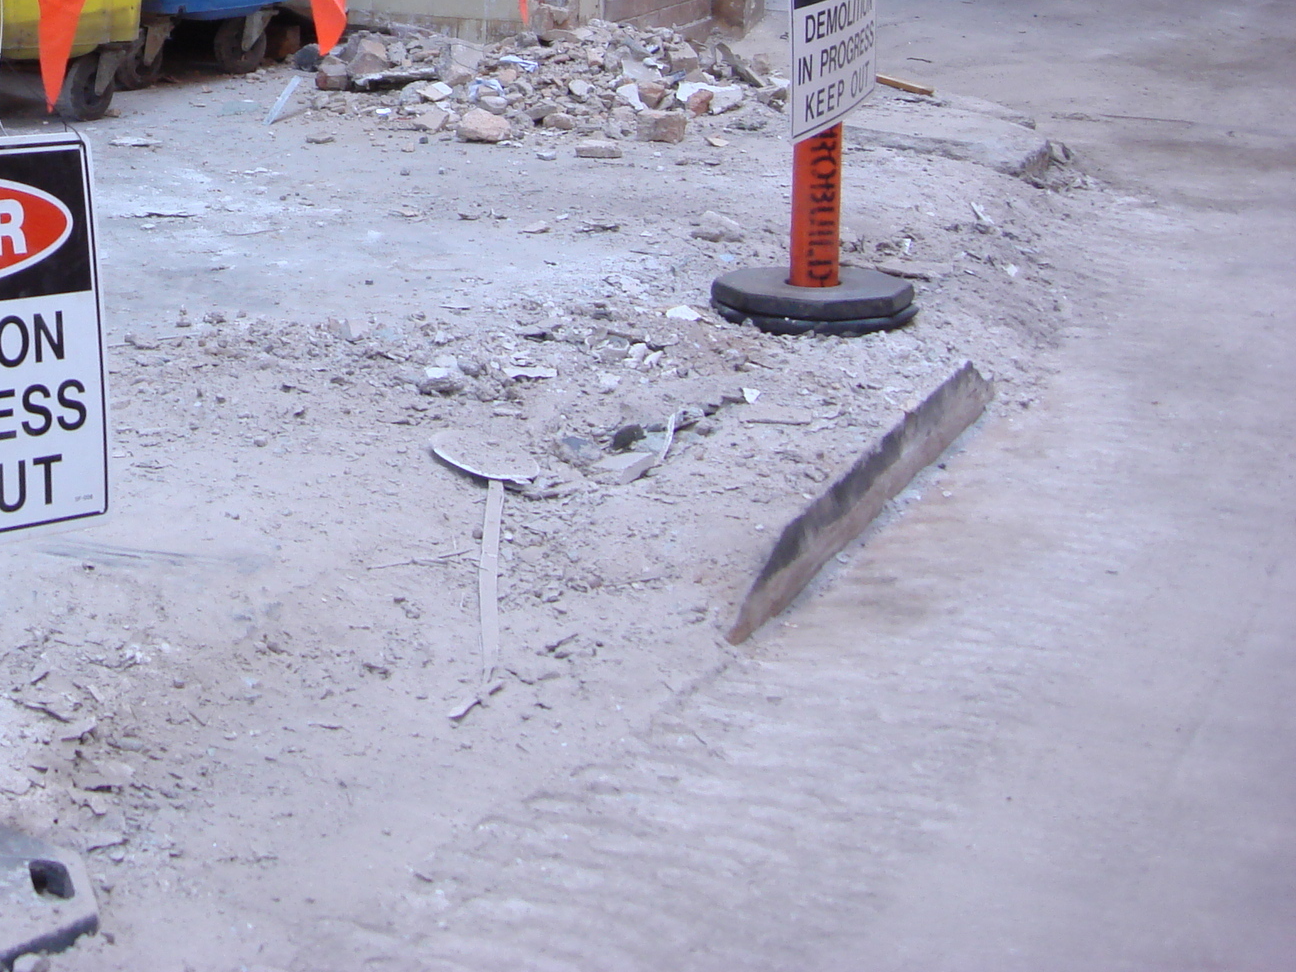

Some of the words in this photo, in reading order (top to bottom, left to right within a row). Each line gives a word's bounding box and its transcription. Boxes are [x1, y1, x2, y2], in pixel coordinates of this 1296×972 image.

[798, 54, 812, 86] IN
[820, 20, 874, 77] PROGRESS
[805, 79, 844, 122] KEEP
[851, 61, 870, 98] OUT
[808, 127, 837, 282] ROBUILD
